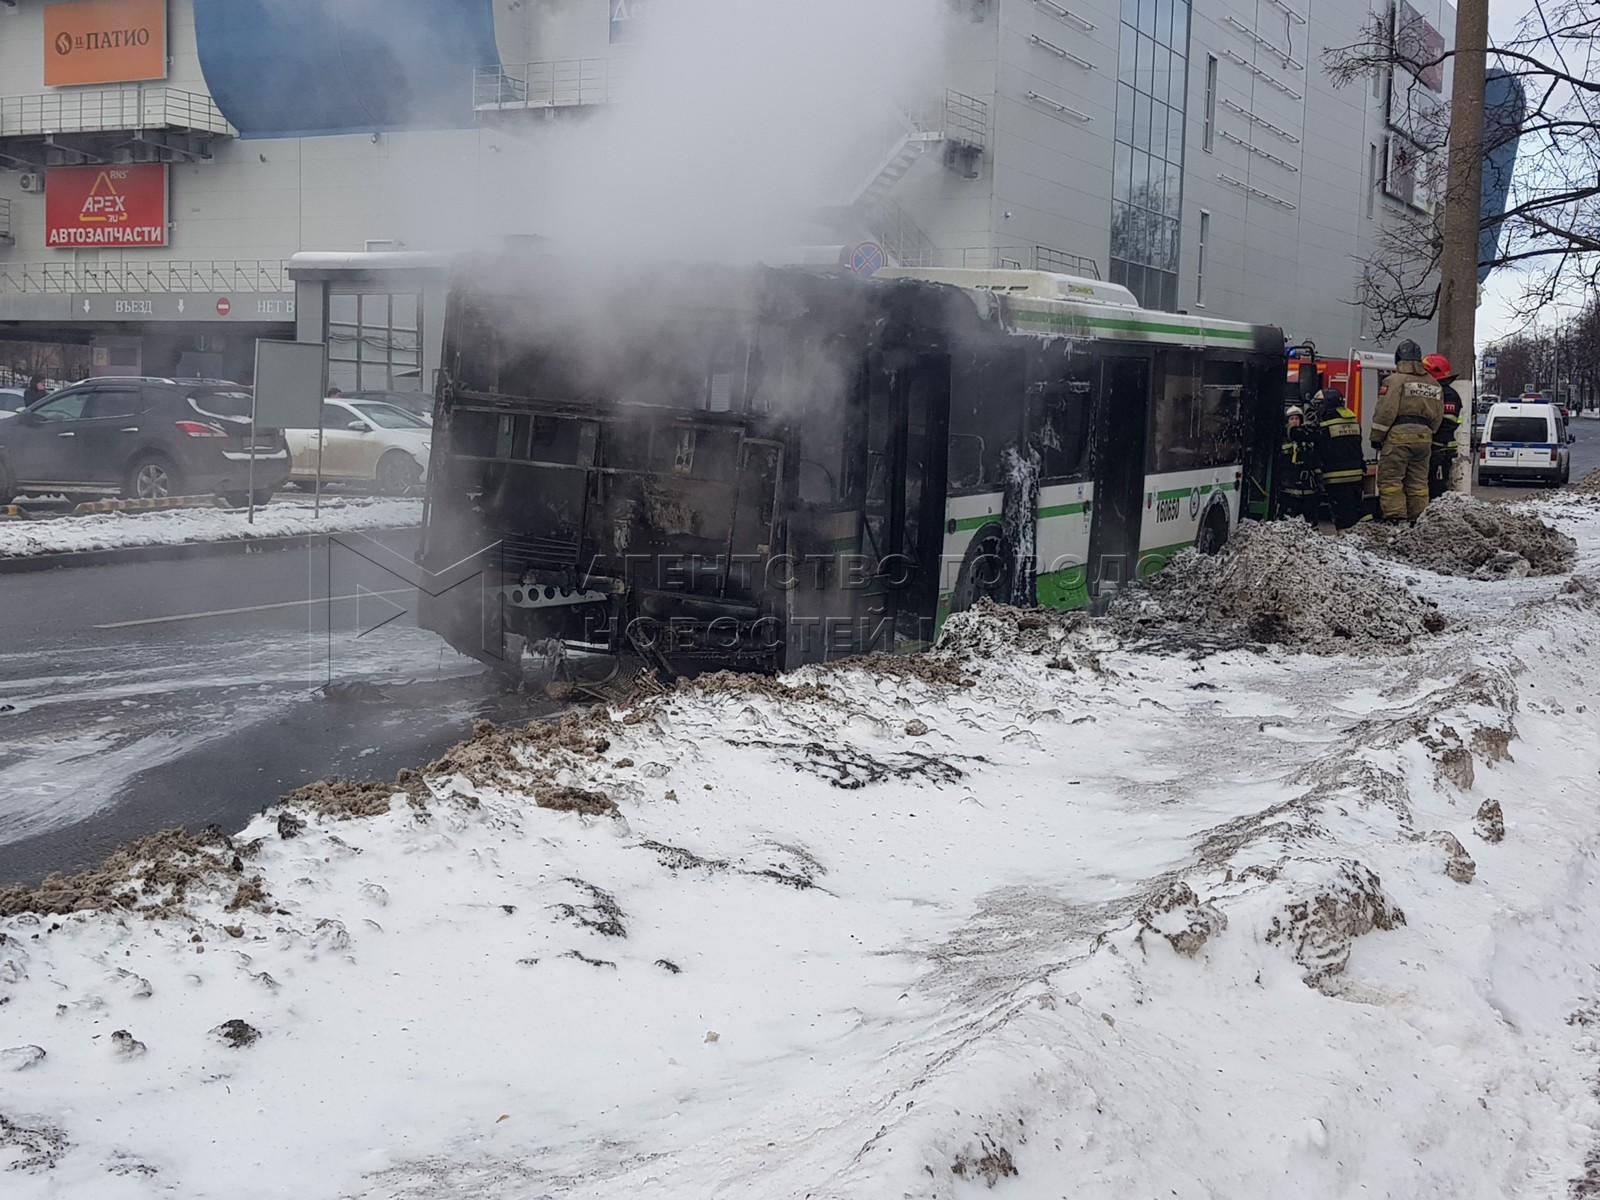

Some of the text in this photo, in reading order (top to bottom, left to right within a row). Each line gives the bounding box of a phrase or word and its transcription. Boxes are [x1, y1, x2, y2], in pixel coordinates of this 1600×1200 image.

[86, 28, 150, 50] ПАТИО
[81, 195, 126, 213] APEX
[49, 226, 162, 243] АВТОЗАПЧАСТИ
[115, 300, 152, 314] ВЪЕЗД
[257, 300, 295, 313] НЕТ В
[1156, 497, 1180, 523] 160650
